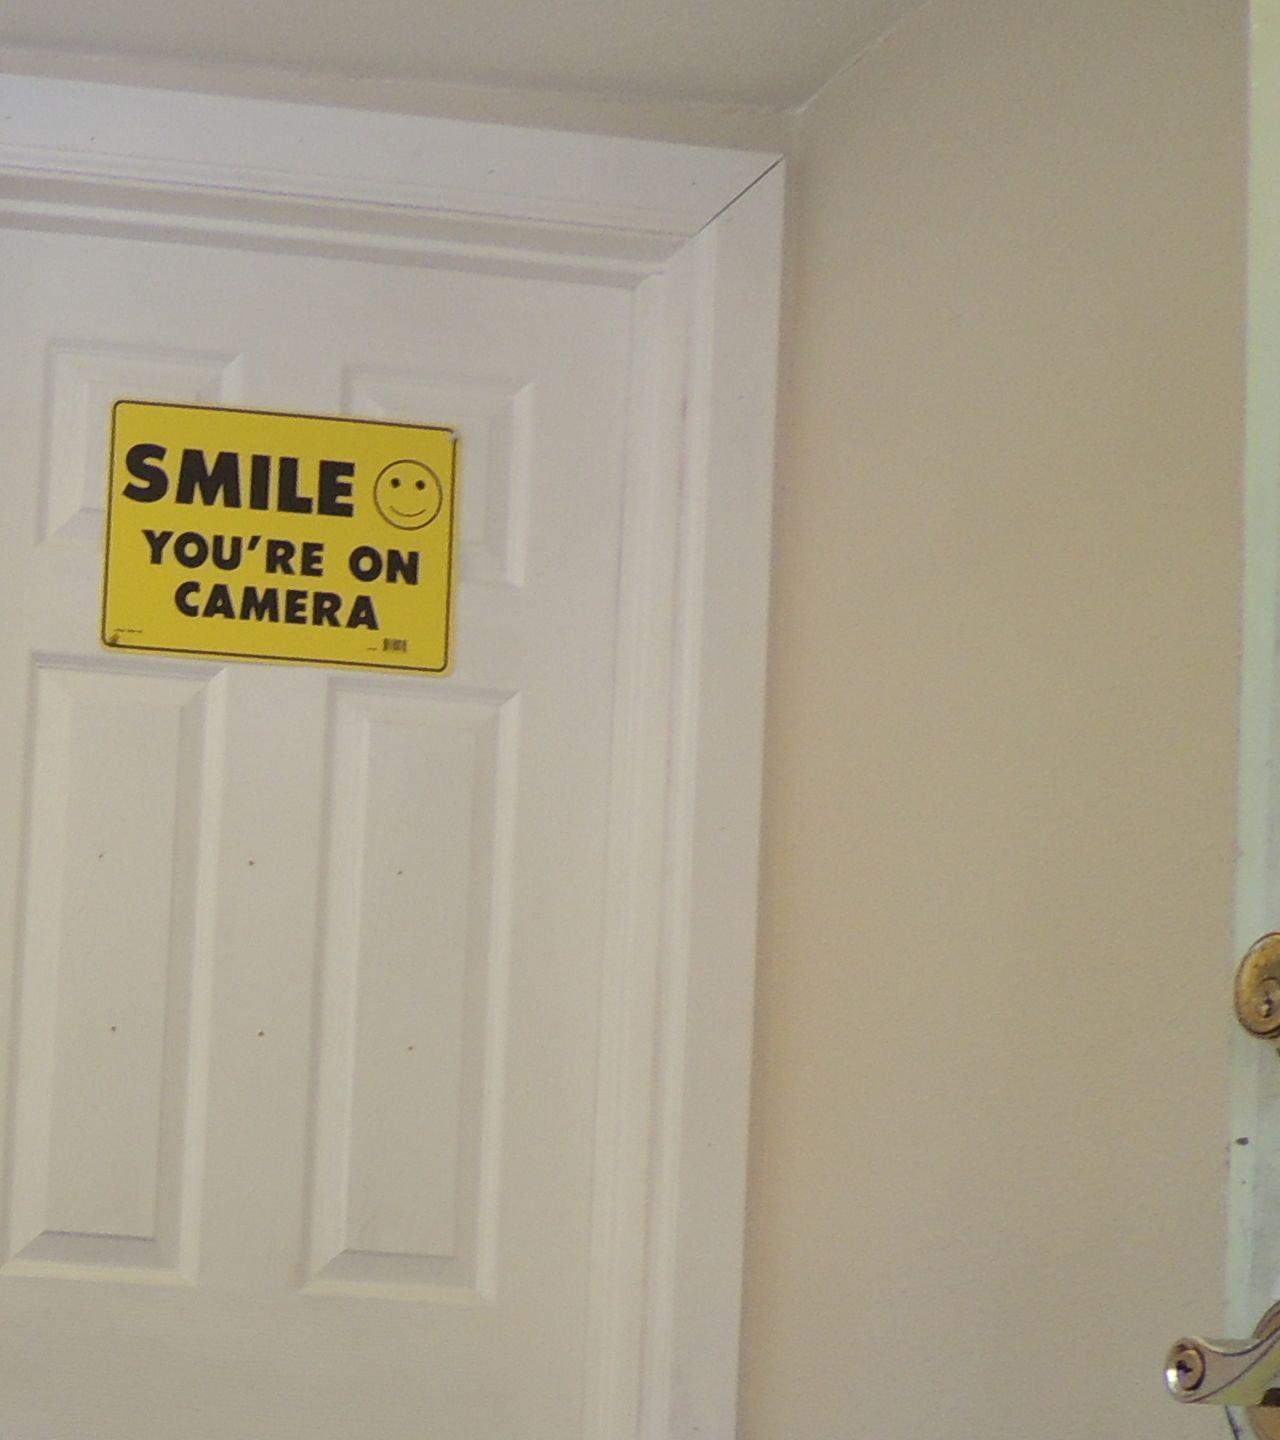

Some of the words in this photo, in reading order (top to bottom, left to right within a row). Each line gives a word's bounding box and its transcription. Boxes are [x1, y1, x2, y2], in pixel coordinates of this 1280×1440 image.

[122, 443, 356, 517] SMILE
[142, 529, 324, 577] YOU'RE
[349, 545, 419, 586] ON
[174, 581, 379, 631] CAMERA
